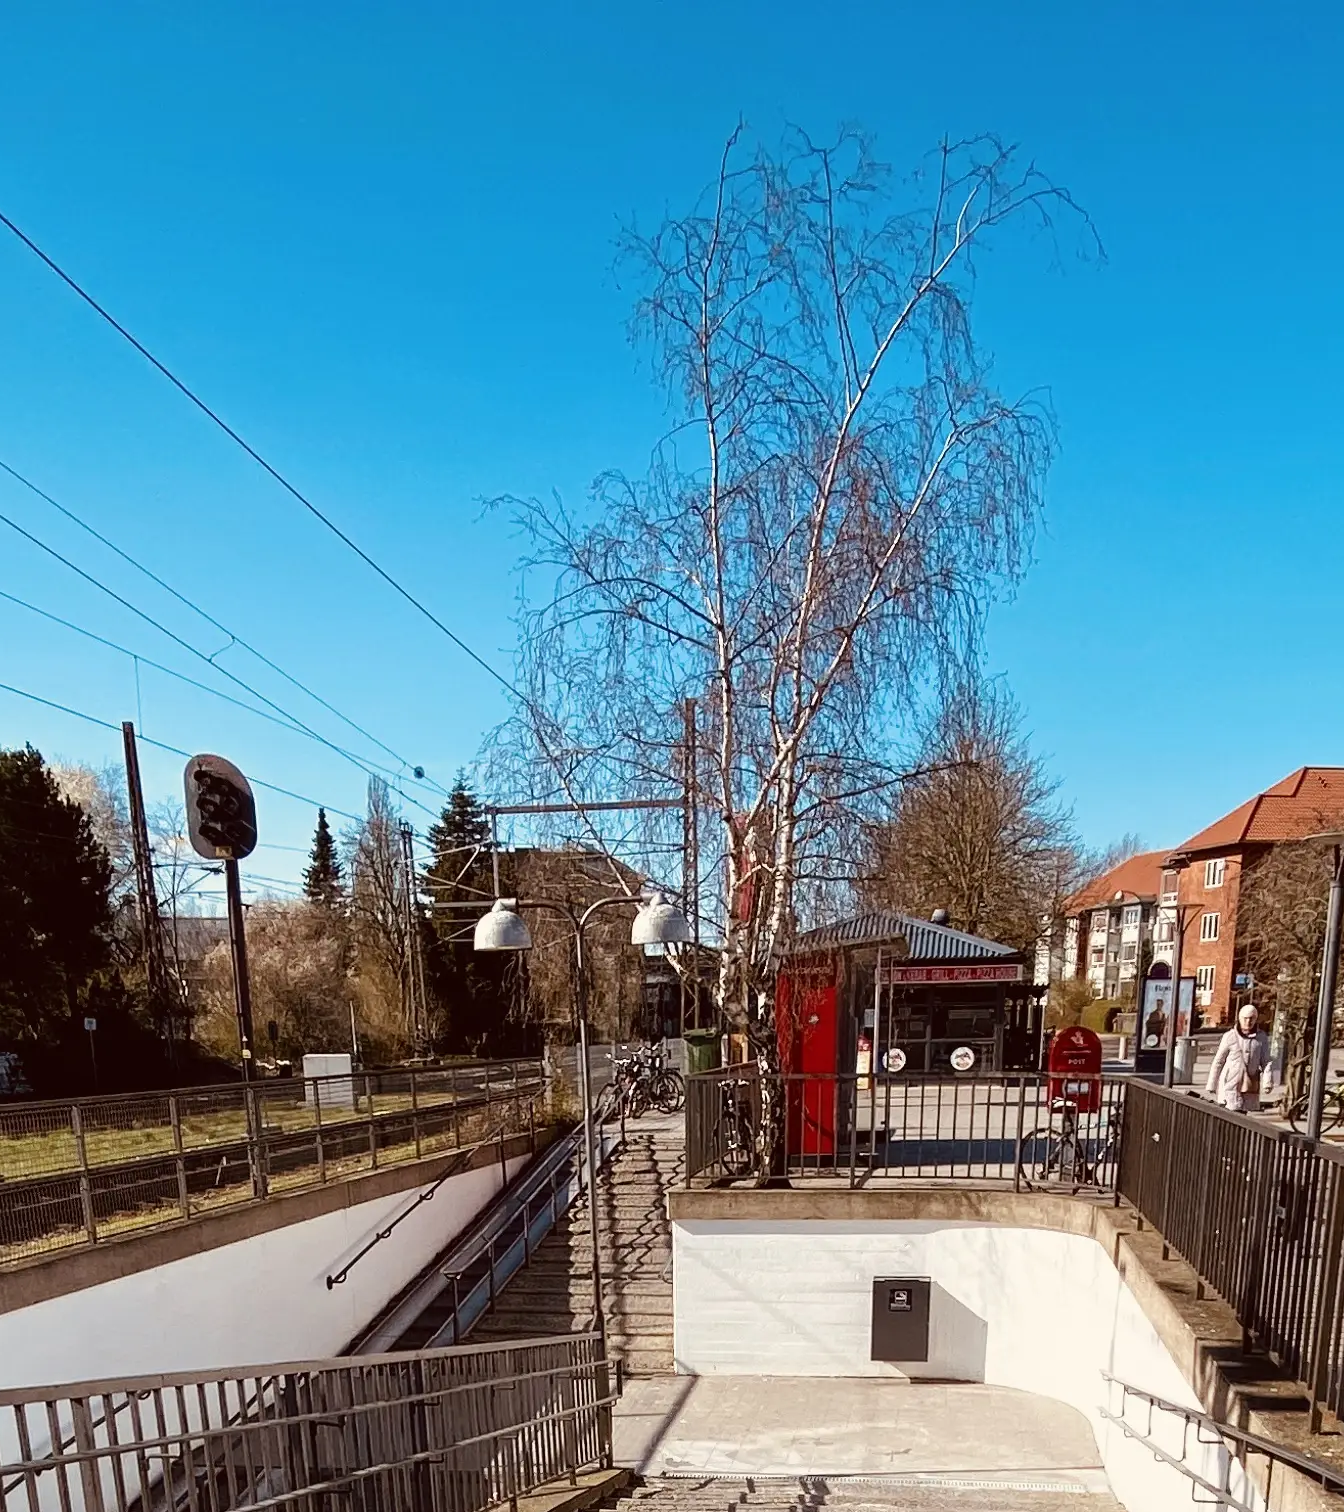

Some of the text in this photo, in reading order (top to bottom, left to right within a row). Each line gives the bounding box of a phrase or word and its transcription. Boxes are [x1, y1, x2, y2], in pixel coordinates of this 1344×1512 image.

[931, 968, 949, 981] GRILL
[954, 967, 972, 980] PIZZA
[977, 967, 995, 979] PIZZA
[996, 966, 1017, 979] HOUSE
